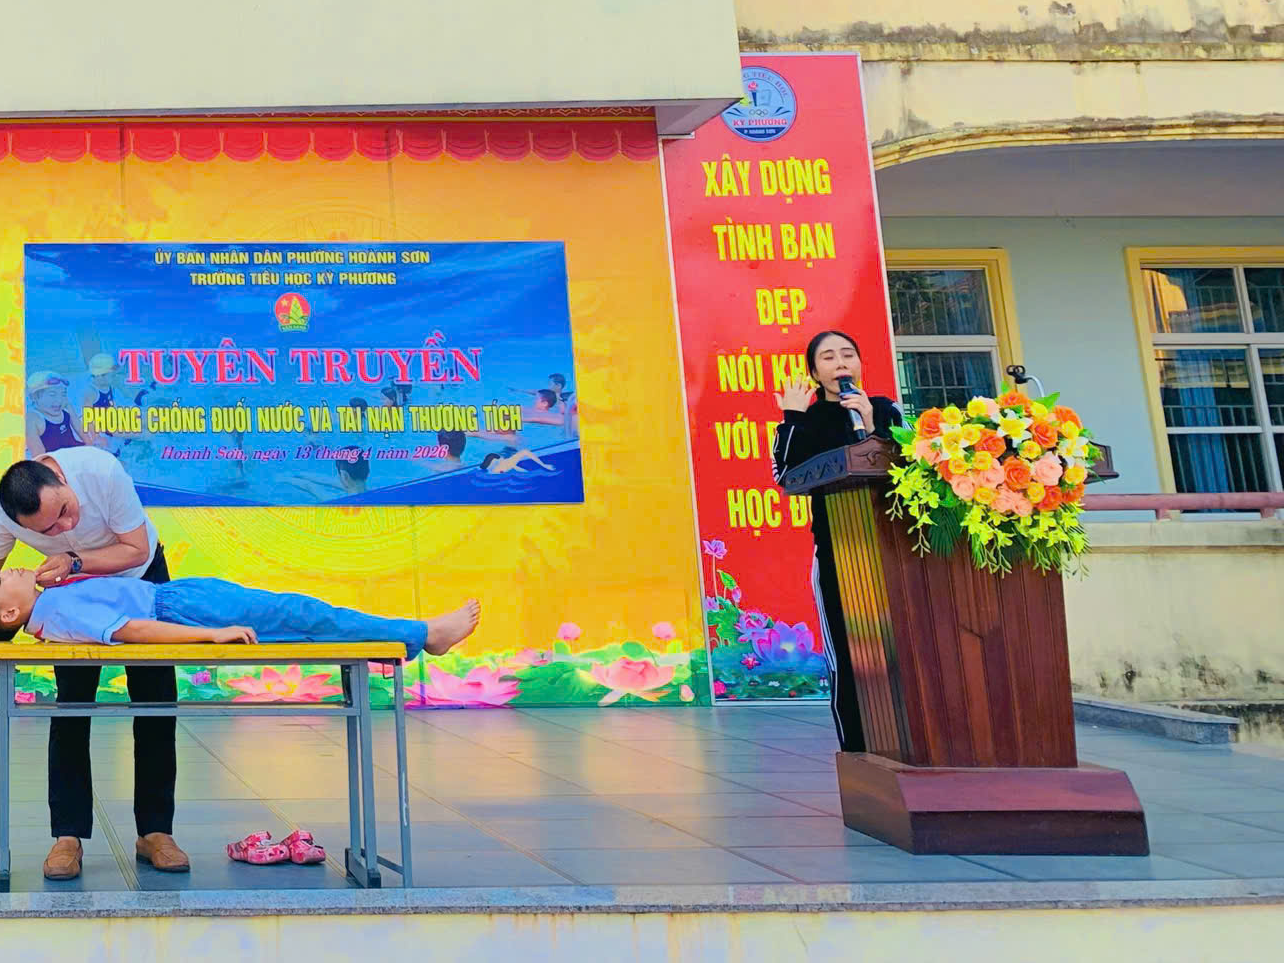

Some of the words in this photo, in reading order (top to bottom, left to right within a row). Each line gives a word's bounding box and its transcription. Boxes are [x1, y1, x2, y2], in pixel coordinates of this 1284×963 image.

[701, 153, 751, 197] XÂY
[759, 156, 832, 204] DỰNG
[176, 252, 205, 264] BAN
[210, 248, 249, 264] NHÂN
[253, 248, 283, 264] DÂN
[348, 248, 397, 264] HOÀNH
[401, 250, 430, 264] SƠN
[713, 216, 775, 261] TÌNH
[780, 222, 836, 268] BẠN
[190, 268, 245, 286] TRƯỜNG
[250, 267, 279, 285] TIỂU
[284, 272, 312, 288] HỌC
[339, 270, 396, 285] PHƯƠNG
[756, 289, 808, 334] ĐẸP
[119, 338, 277, 385] TUYÊN
[289, 329, 482, 385] TRUYỀN
[717, 346, 765, 392] NÓI
[83, 400, 142, 433] PHÒNG
[147, 398, 206, 433] CHỐNG
[211, 397, 252, 433] ĐUỐI
[257, 400, 305, 433] NƯỚC
[309, 400, 333, 433] VÀ
[337, 405, 362, 433] TAI
[367, 405, 405, 439] NẠN
[409, 403, 479, 433] THƯƠNG
[481, 398, 522, 432] TÍCH
[715, 413, 760, 459] VỚI
[160, 445, 211, 460] Hoành
[217, 446, 248, 462] Sơn,
[251, 446, 288, 463] ngày
[294, 446, 312, 460] 13
[316, 445, 359, 463] tháng
[361, 446, 371, 460] 4
[376, 446, 409, 460] năm
[412, 445, 449, 459] 2026
[727, 488, 782, 536] HỌC
